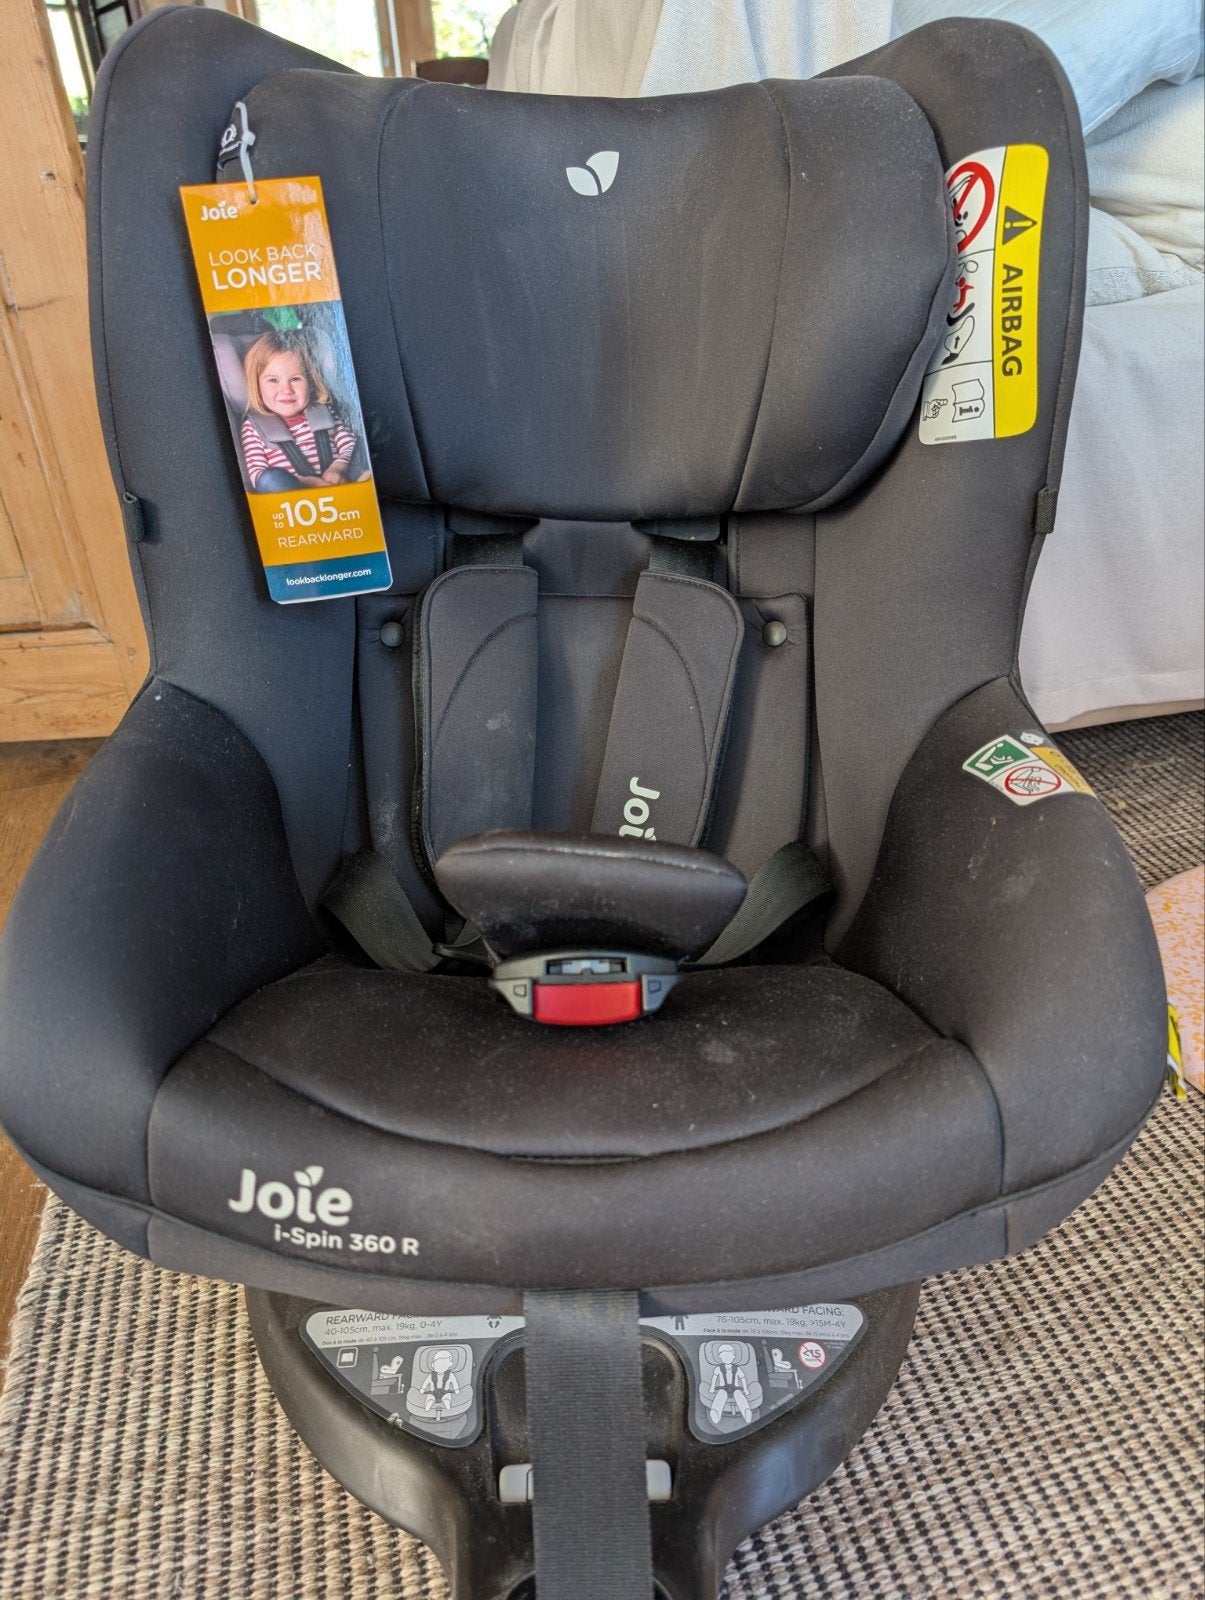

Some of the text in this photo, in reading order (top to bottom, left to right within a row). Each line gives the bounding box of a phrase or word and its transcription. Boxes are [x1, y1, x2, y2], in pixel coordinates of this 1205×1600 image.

[201, 201, 238, 221] Joie
[208, 243, 318, 267] LOOK BACK
[211, 261, 322, 290] LONGER
[1001, 263, 1023, 377] AIRBAG
[272, 512, 285, 521] up
[274, 520, 284, 529] to
[277, 527, 364, 549] REARWARD
[286, 568, 372, 587] lookbacklonger.com
[228, 1165, 354, 1227] Joie
[274, 1223, 420, 1256] i-Spin 360 R
[326, 1313, 389, 1325] REARWARD
[802, 1306, 845, 1316] FACING:
[420, 1320, 442, 1328] 0-4Y
